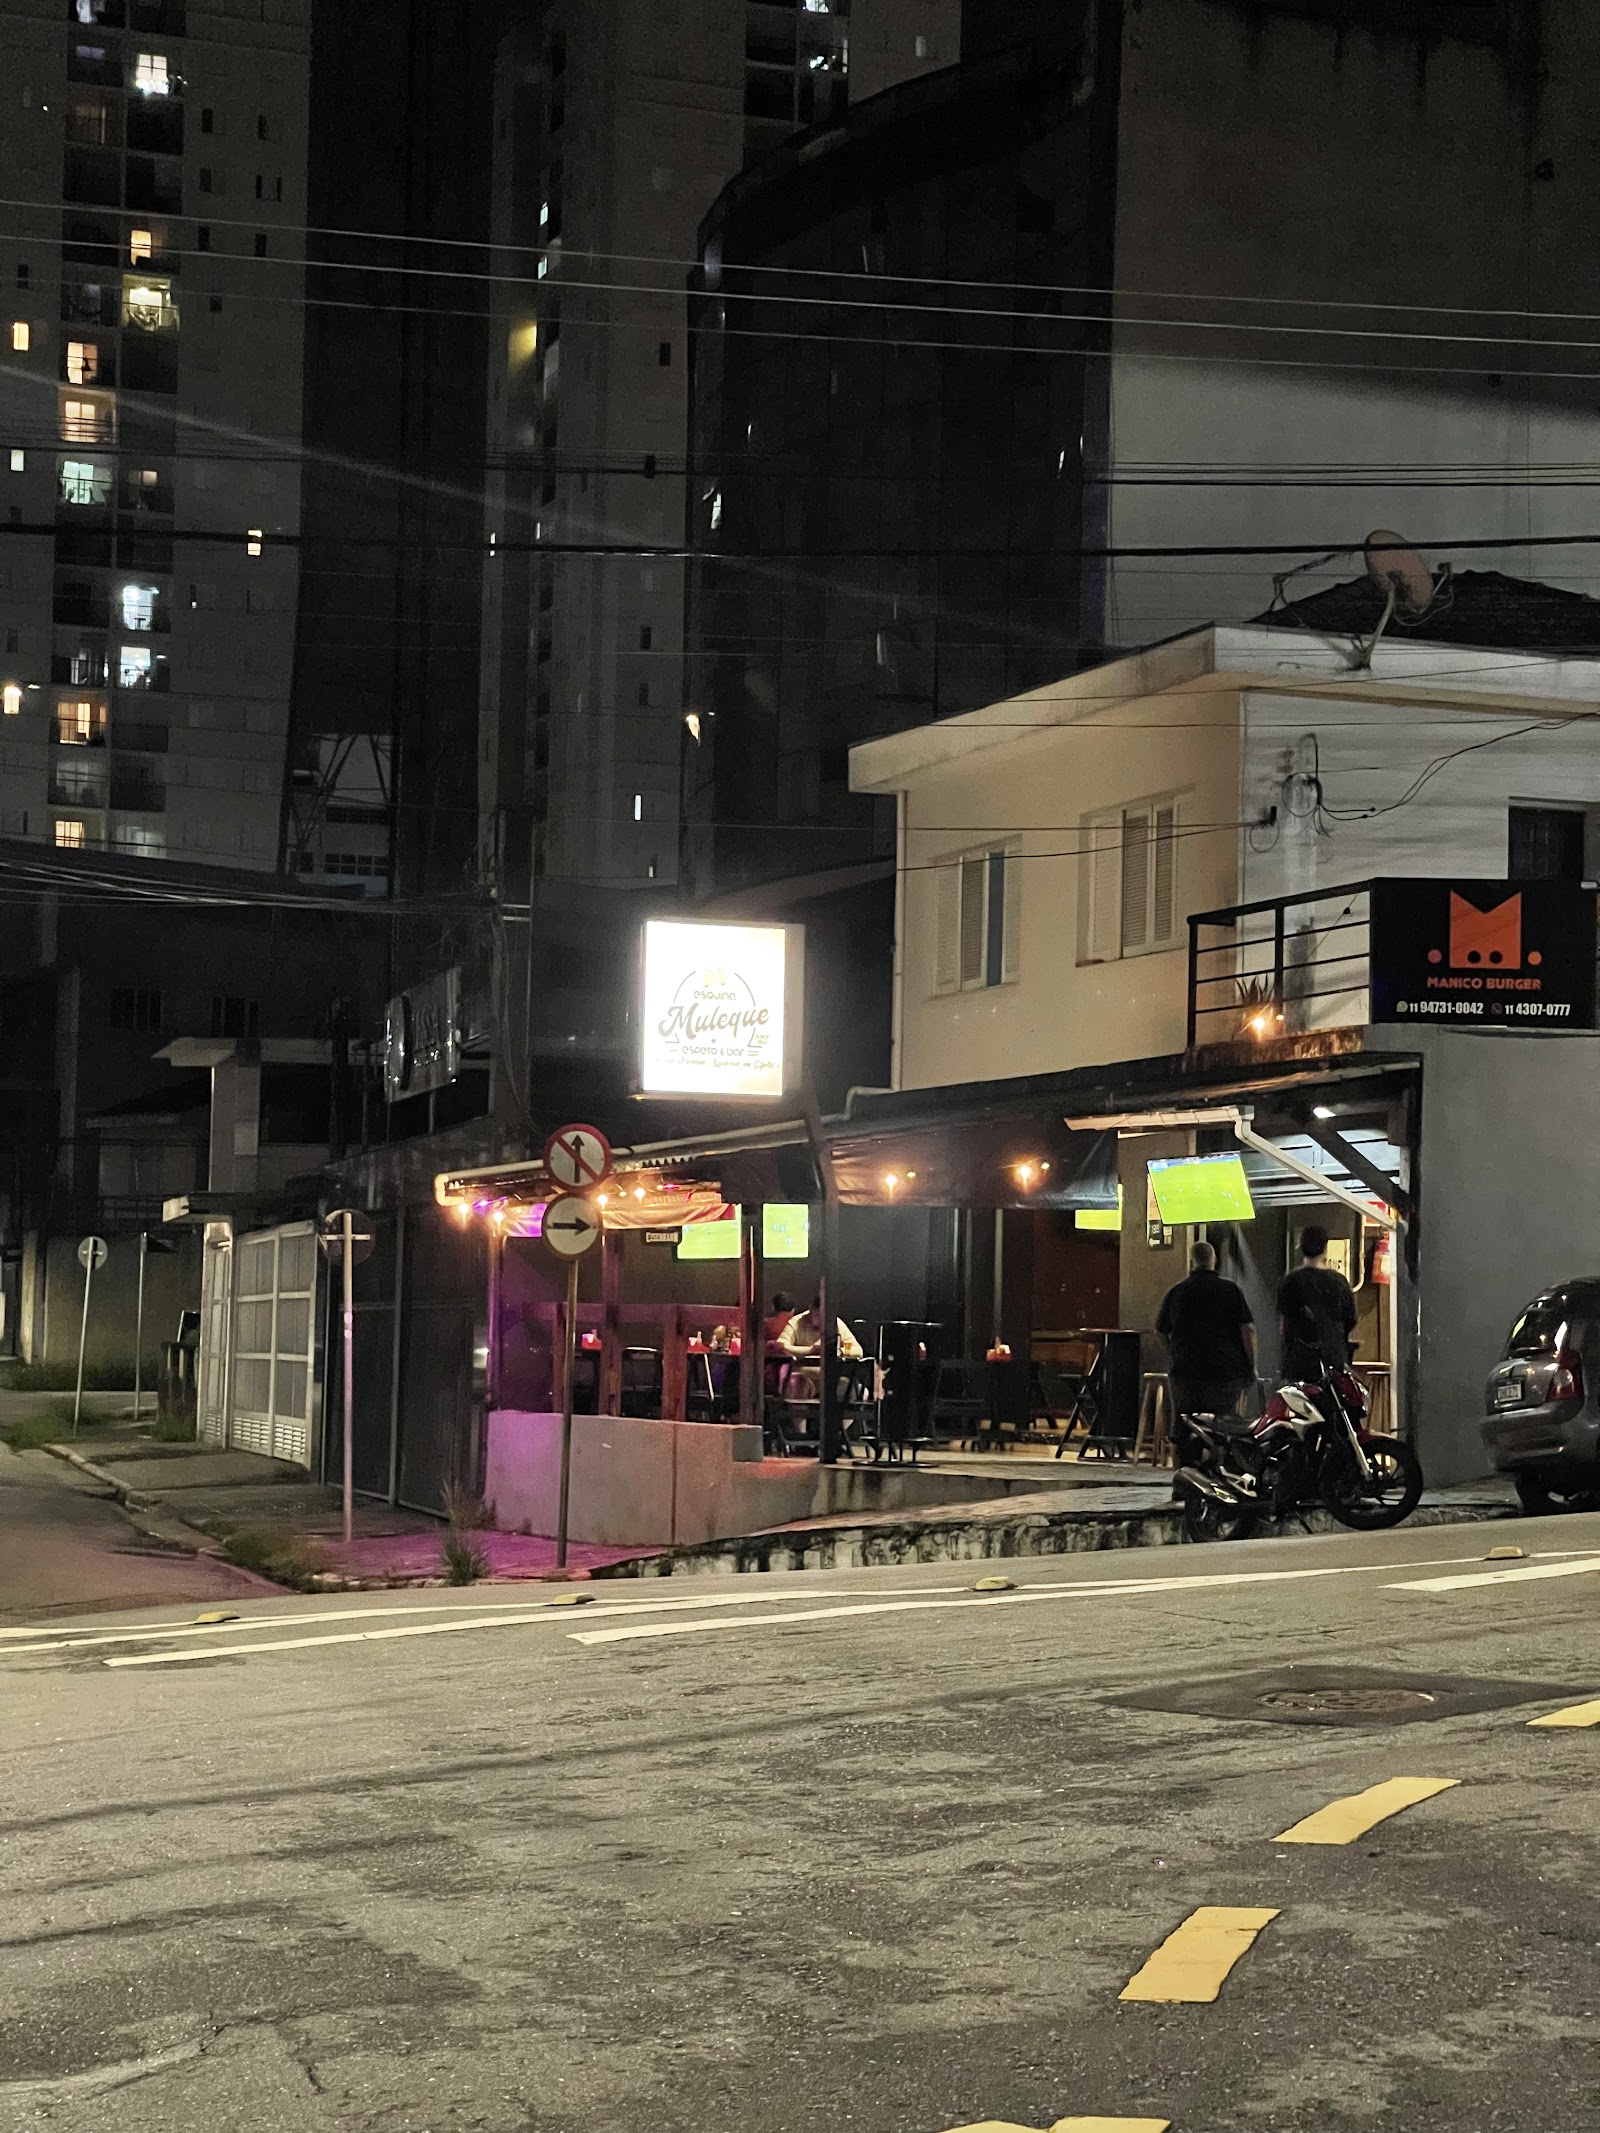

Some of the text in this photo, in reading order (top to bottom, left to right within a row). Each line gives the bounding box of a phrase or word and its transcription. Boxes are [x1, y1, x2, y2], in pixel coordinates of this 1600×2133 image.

[1427, 977, 1541, 990] MANICO BURGER
[1409, 1001, 1484, 1014] 11 94731-0042
[1505, 1003, 1571, 1016] 11 4307-0777
[658, 1002, 770, 1040] Muleque
